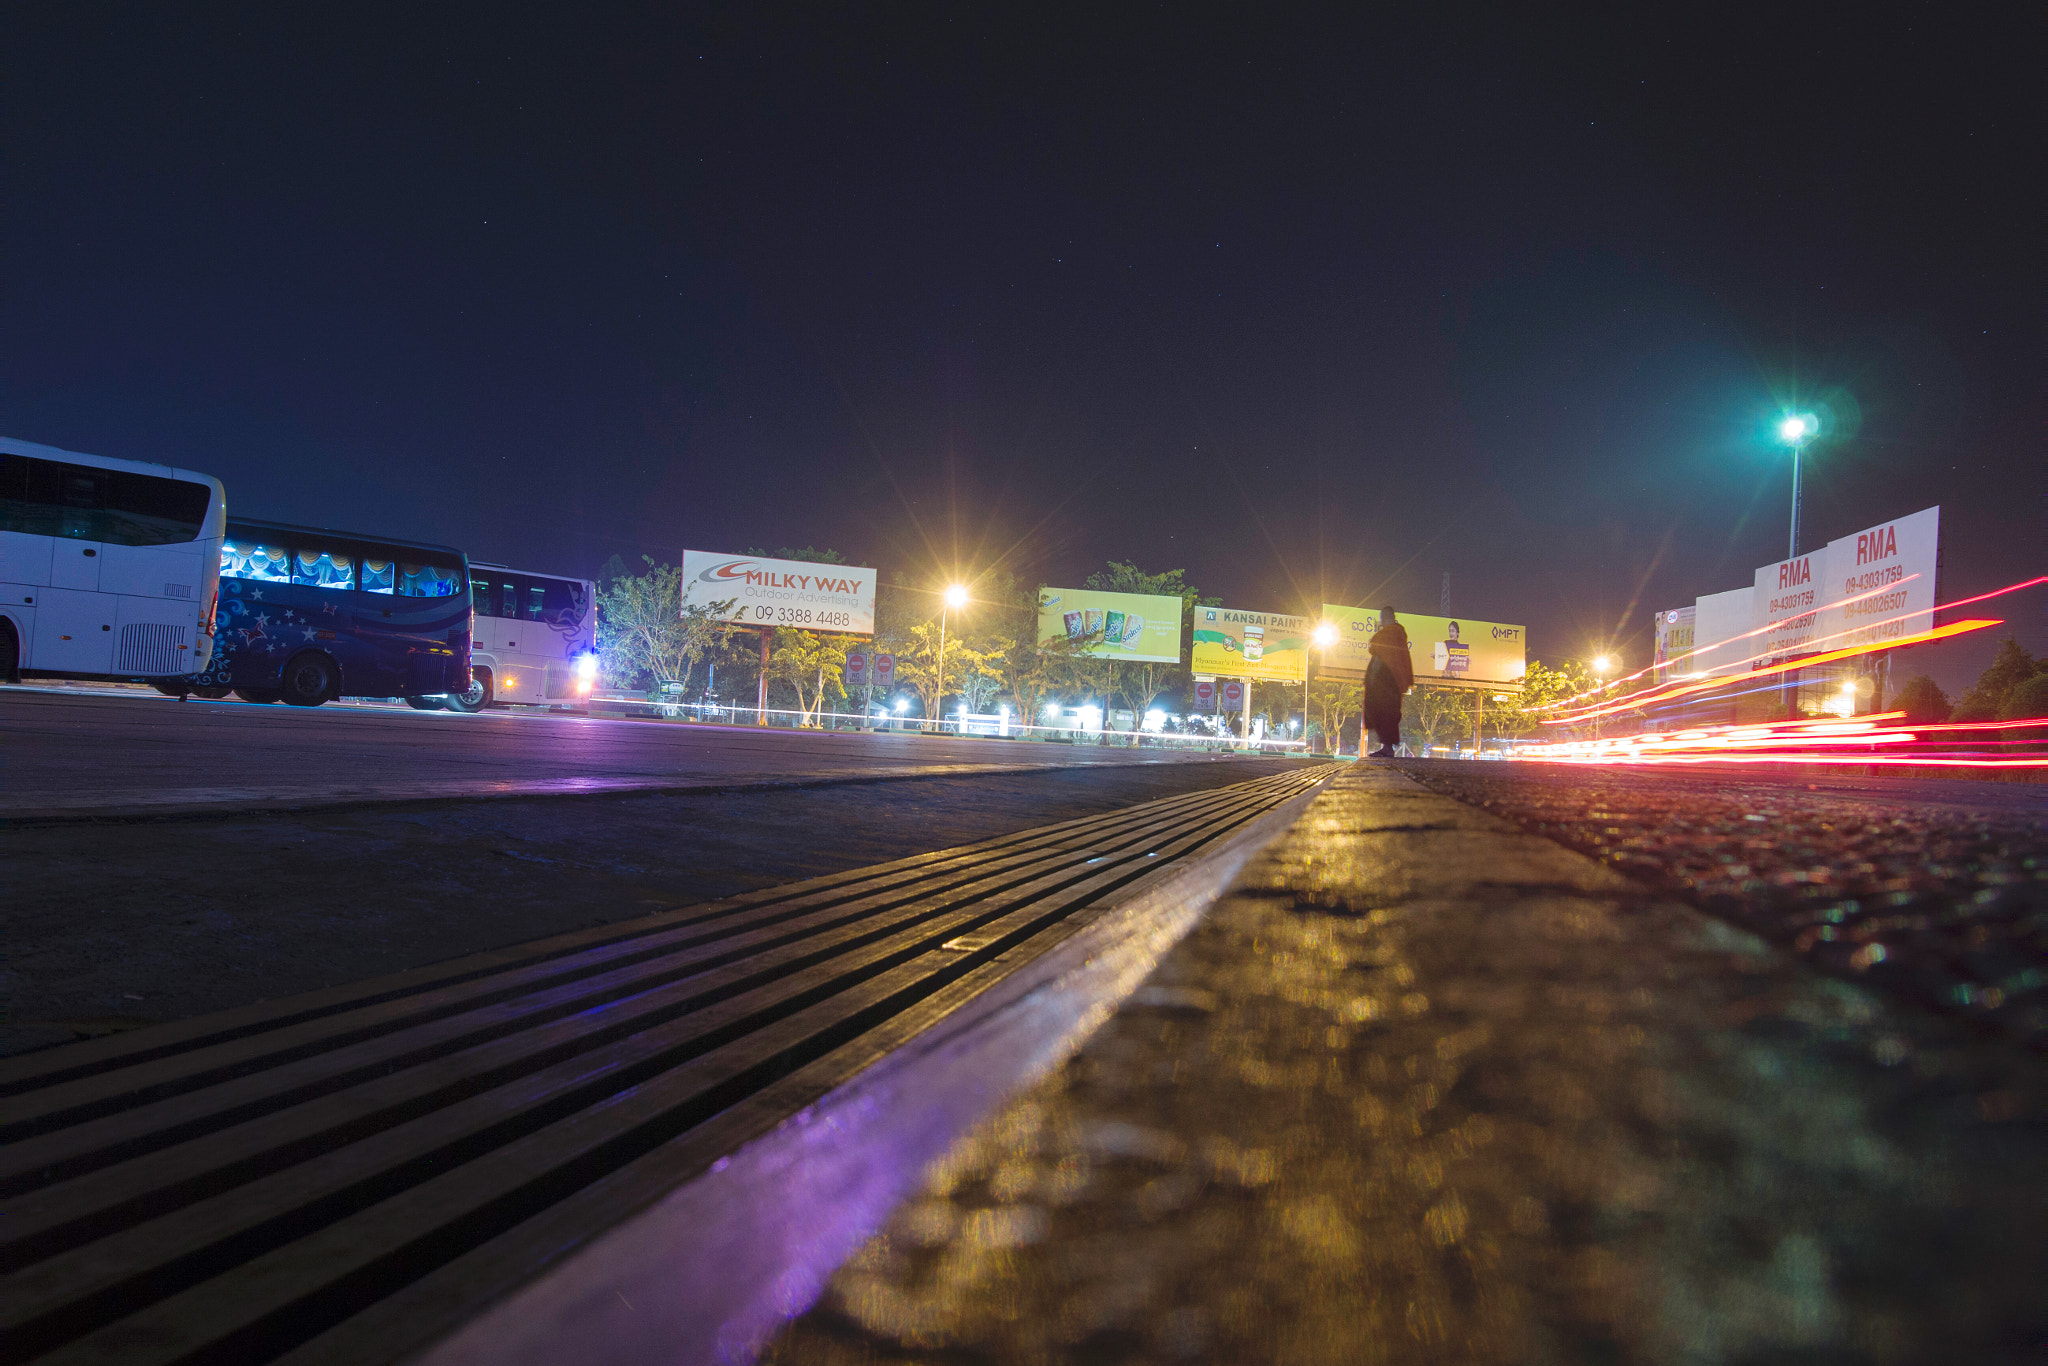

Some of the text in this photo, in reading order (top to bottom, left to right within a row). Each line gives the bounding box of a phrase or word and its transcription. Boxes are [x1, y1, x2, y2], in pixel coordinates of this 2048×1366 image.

[1857, 525, 1897, 566] RMA
[745, 570, 863, 595] MILKY WAY
[1778, 557, 1811, 590] RMA
[1845, 564, 1903, 594] 09-43031759
[745, 586, 859, 608] Outdoor Advertising
[1769, 590, 1814, 613] 09-43031759
[1844, 590, 1908, 619] 09-448026507
[755, 605, 774, 620] 09
[777, 607, 812, 624] 3388
[816, 610, 850, 627] 4488
[1223, 612, 1304, 628] KANSAI PAINT
[1498, 628, 1520, 639] MPT
